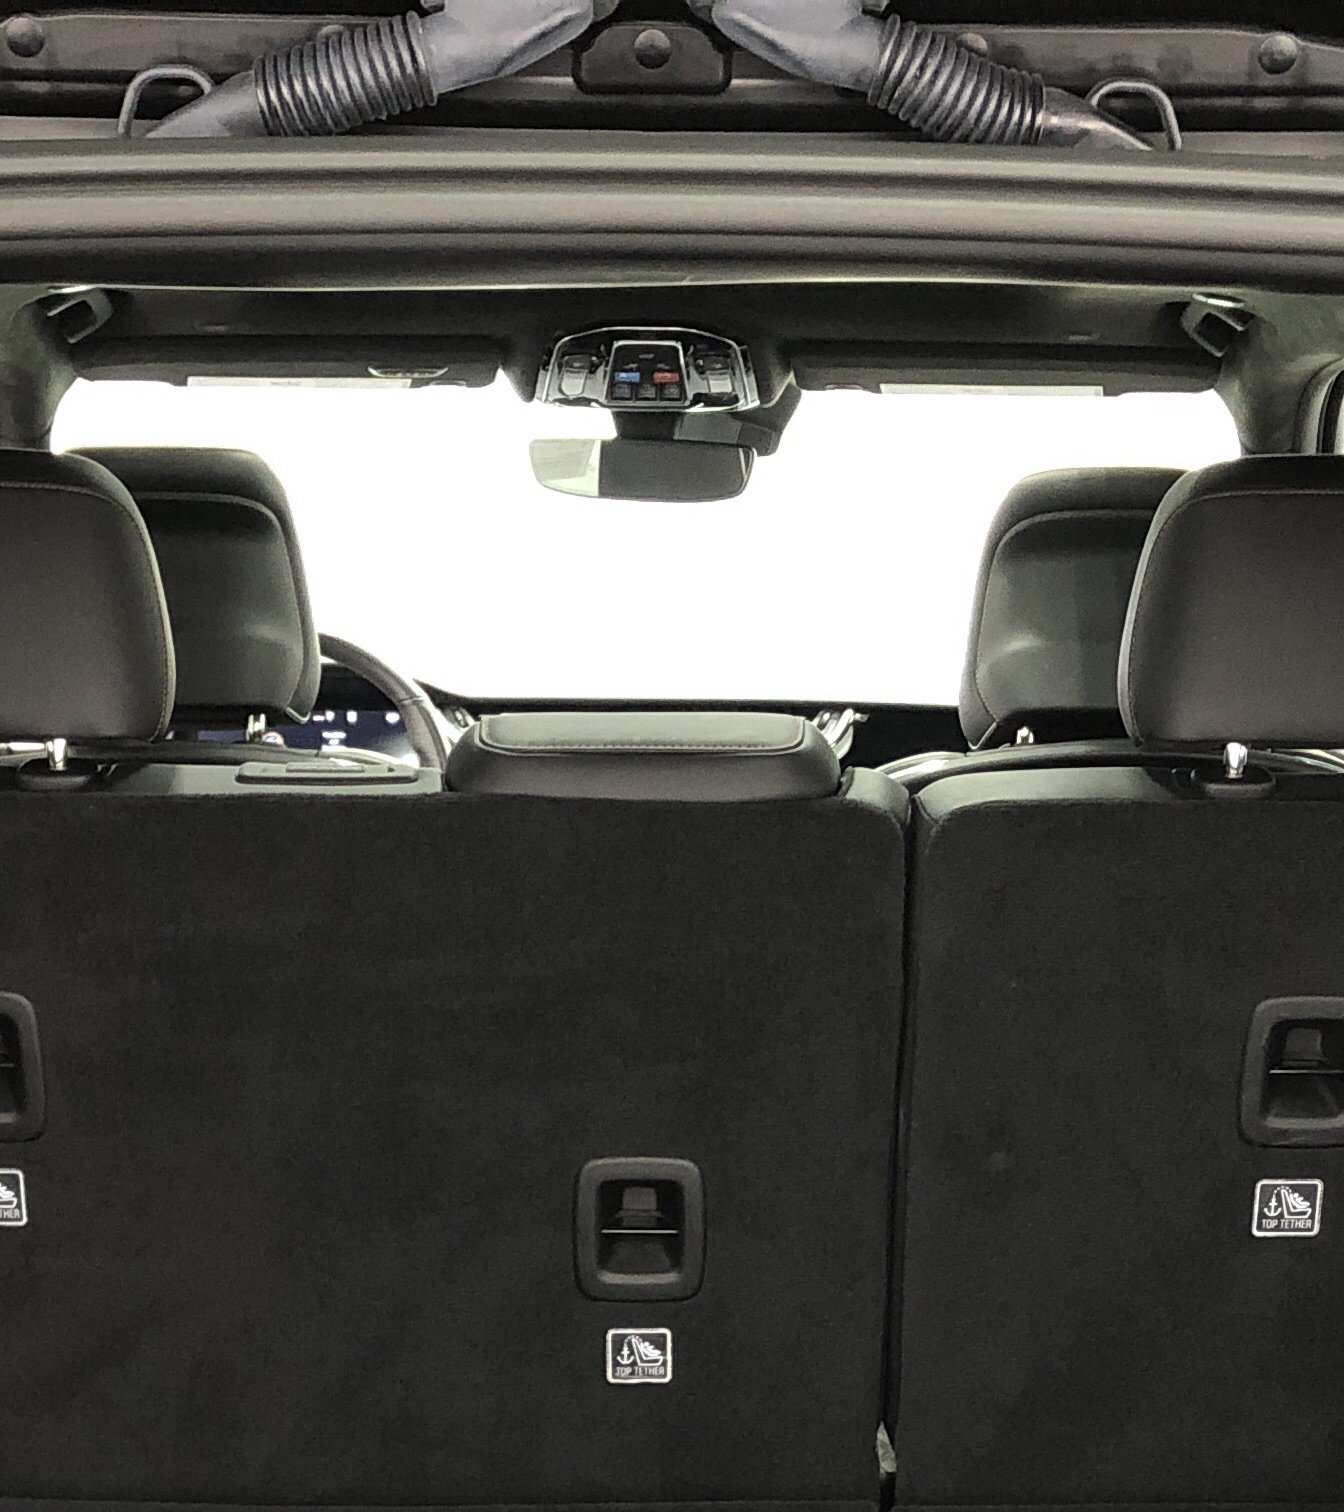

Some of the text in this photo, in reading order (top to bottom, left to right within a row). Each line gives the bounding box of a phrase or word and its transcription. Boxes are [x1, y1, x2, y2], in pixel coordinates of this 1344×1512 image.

[1261, 1218, 1313, 1229] TOP TETHER
[615, 1366, 665, 1377] TOP TETHER
